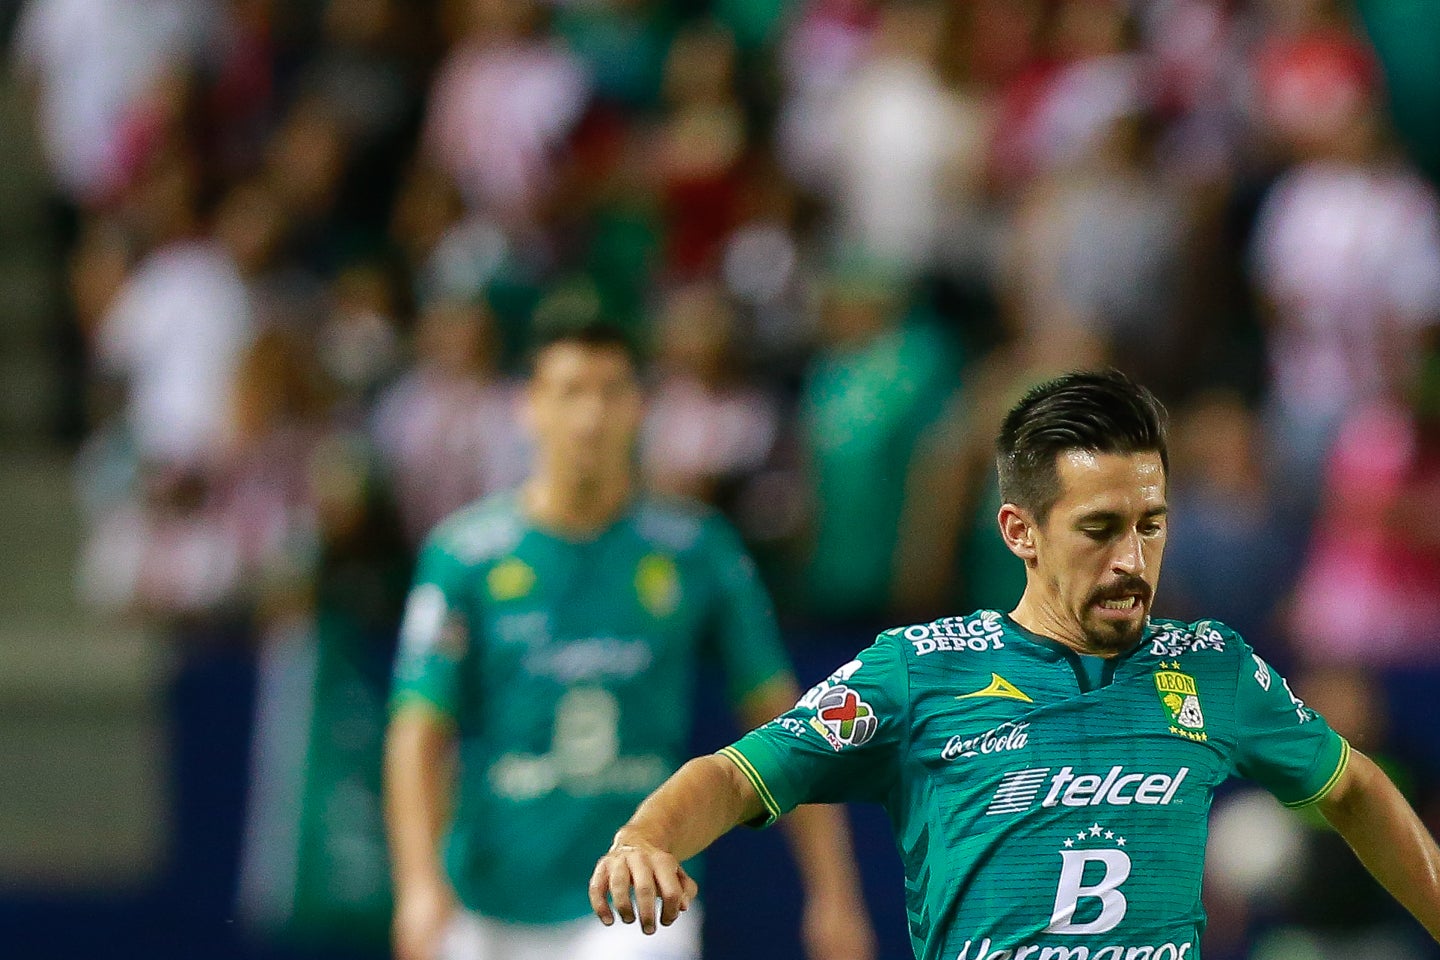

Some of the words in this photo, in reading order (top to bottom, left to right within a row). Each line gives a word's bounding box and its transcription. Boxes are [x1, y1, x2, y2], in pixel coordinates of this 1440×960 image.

[904, 616, 1002, 642] Office
[912, 631, 1005, 656] DEPOT
[1157, 673, 1195, 693] LEON
[1042, 766, 1190, 807] telcel
[1041, 849, 1132, 934] B
